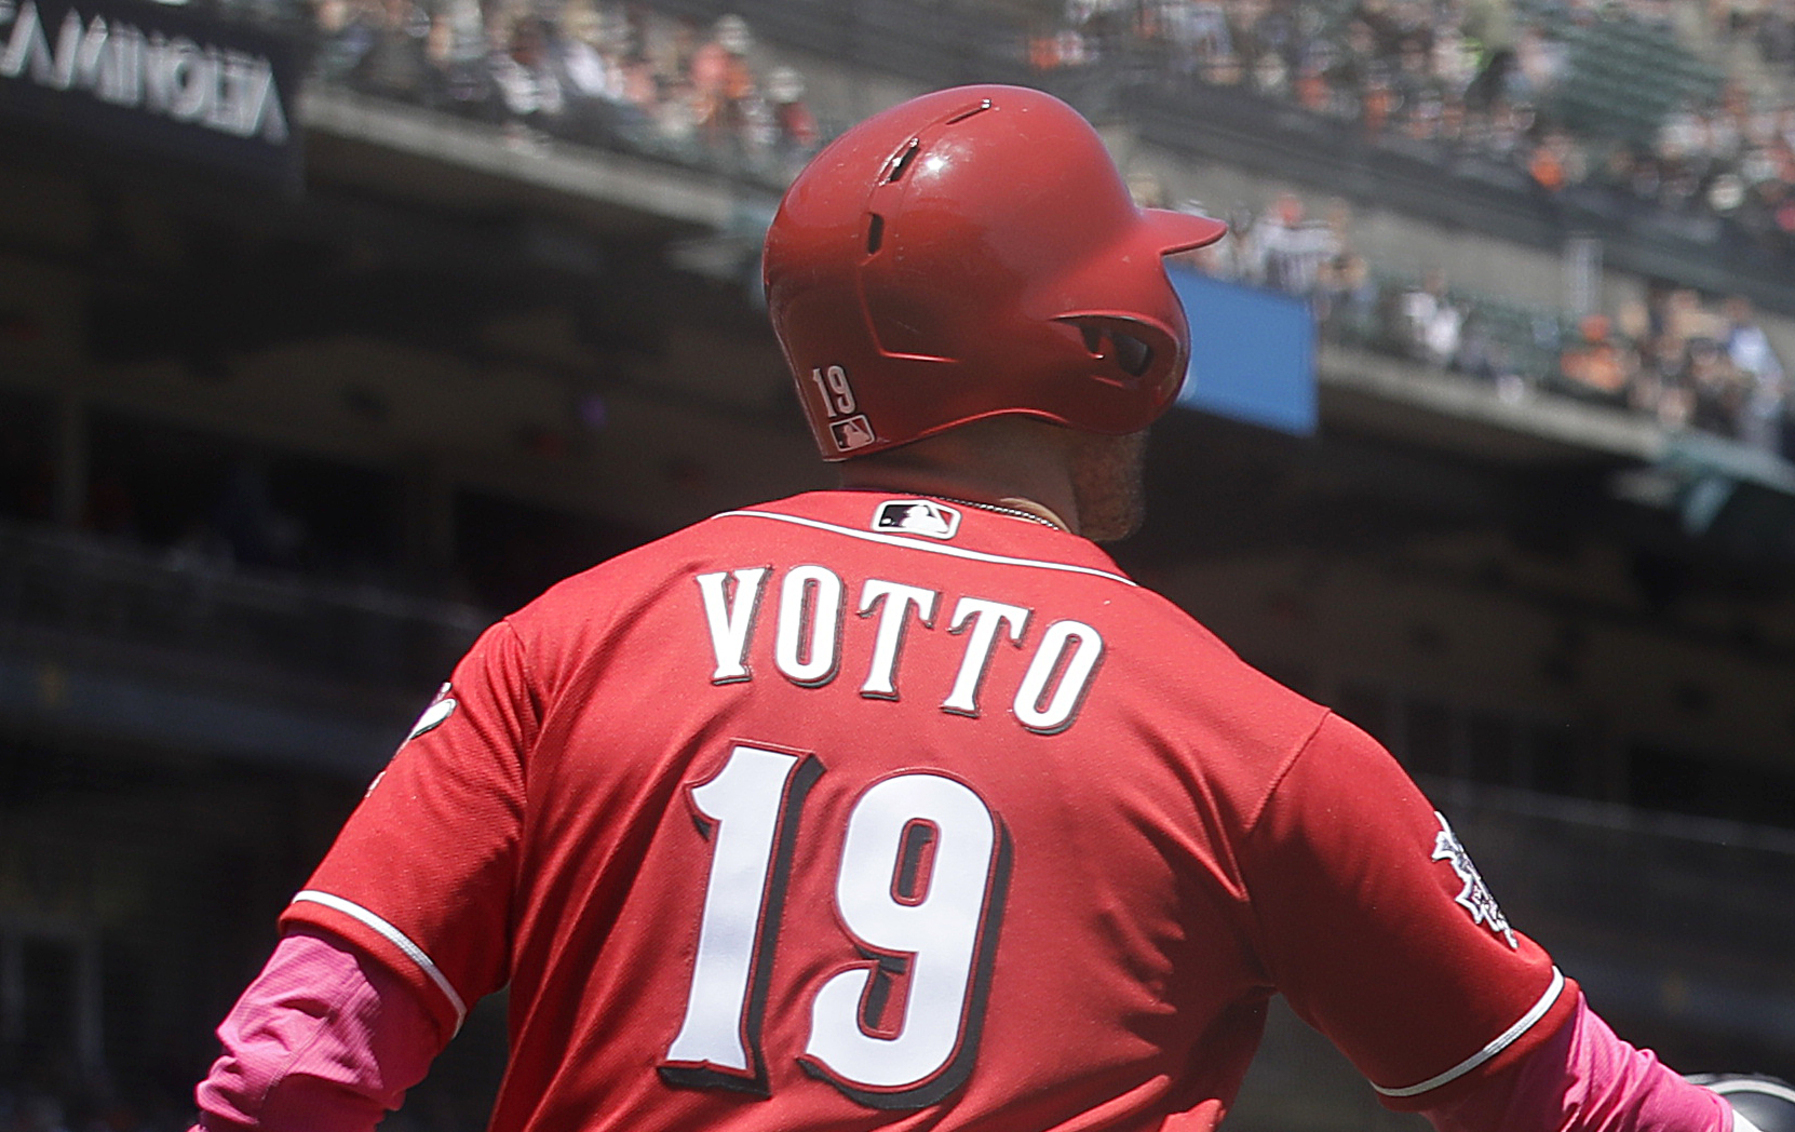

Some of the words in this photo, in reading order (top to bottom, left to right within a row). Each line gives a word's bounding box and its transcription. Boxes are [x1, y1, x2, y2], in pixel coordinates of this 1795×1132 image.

[812, 364, 857, 418] 19
[696, 564, 1106, 735] VOTTO
[657, 739, 1014, 1109] 19
